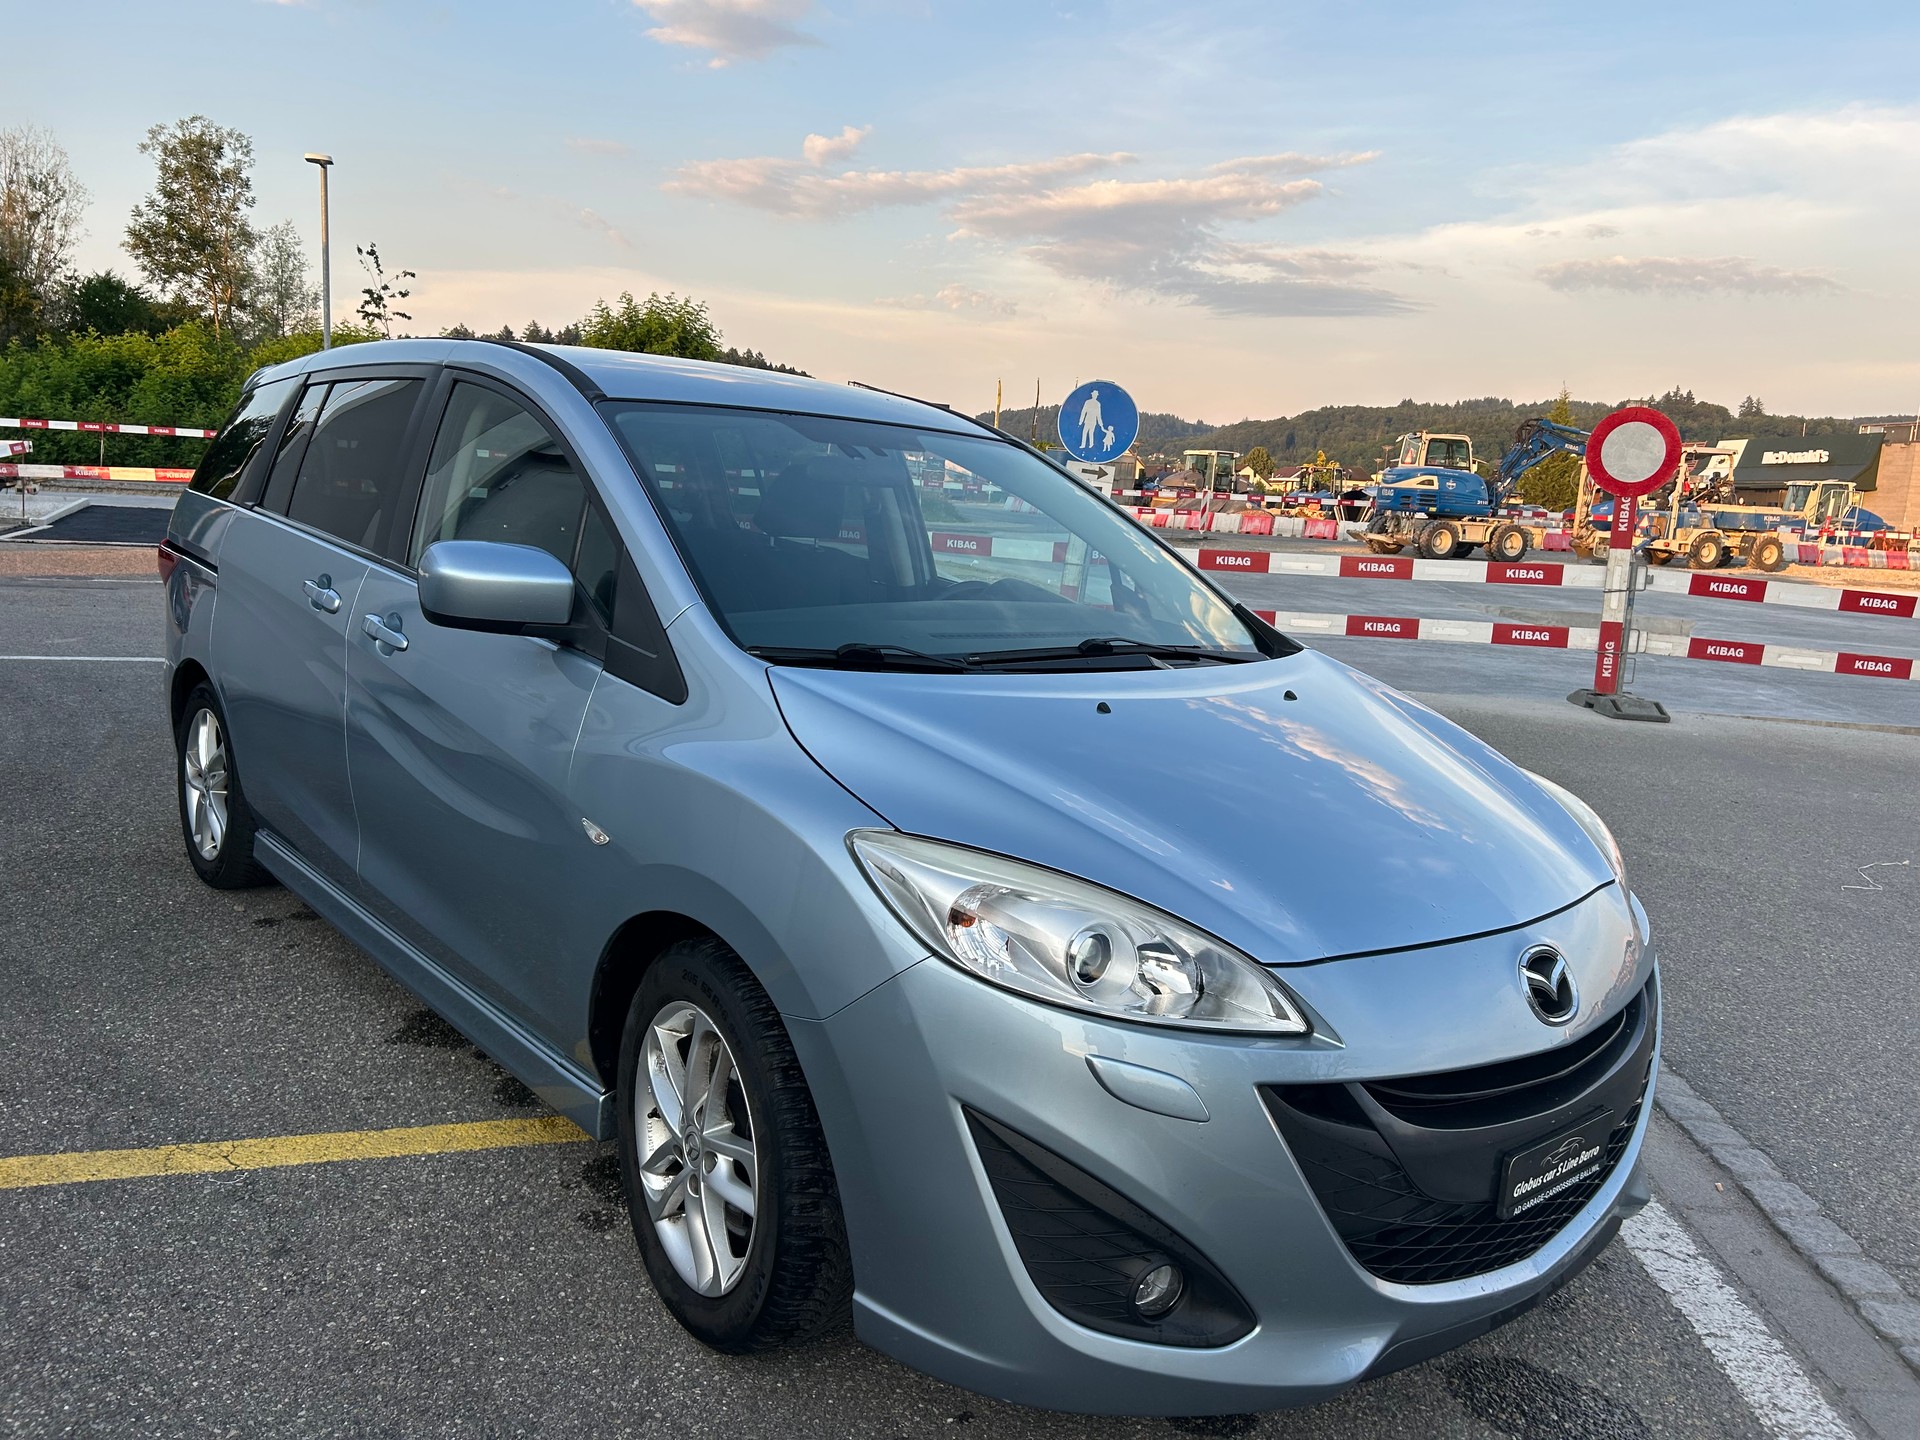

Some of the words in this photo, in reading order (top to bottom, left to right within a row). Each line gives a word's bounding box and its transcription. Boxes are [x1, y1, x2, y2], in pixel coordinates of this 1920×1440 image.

[1761, 449, 1830, 465] McDonald's
[946, 539, 977, 550] KIBAG
[1215, 556, 1251, 566] KIBAG
[1358, 562, 1395, 573] KIBAG
[1506, 568, 1544, 579] KIBAG
[1709, 582, 1748, 595] KIBAG
[1859, 597, 1898, 610] KIBAG
[1364, 622, 1401, 632] KIBAG
[1511, 630, 1550, 641] KIBAG
[1706, 645, 1744, 657] KIBAG
[1602, 641, 1615, 677] KIBAG
[1854, 660, 1892, 672] KIBAG
[1513, 1175, 1543, 1198] Globus
[1543, 1169, 1557, 1183] car
[1556, 1163, 1563, 1176] S
[1562, 1157, 1579, 1173] Line
[1513, 1205, 1522, 1216] AD
